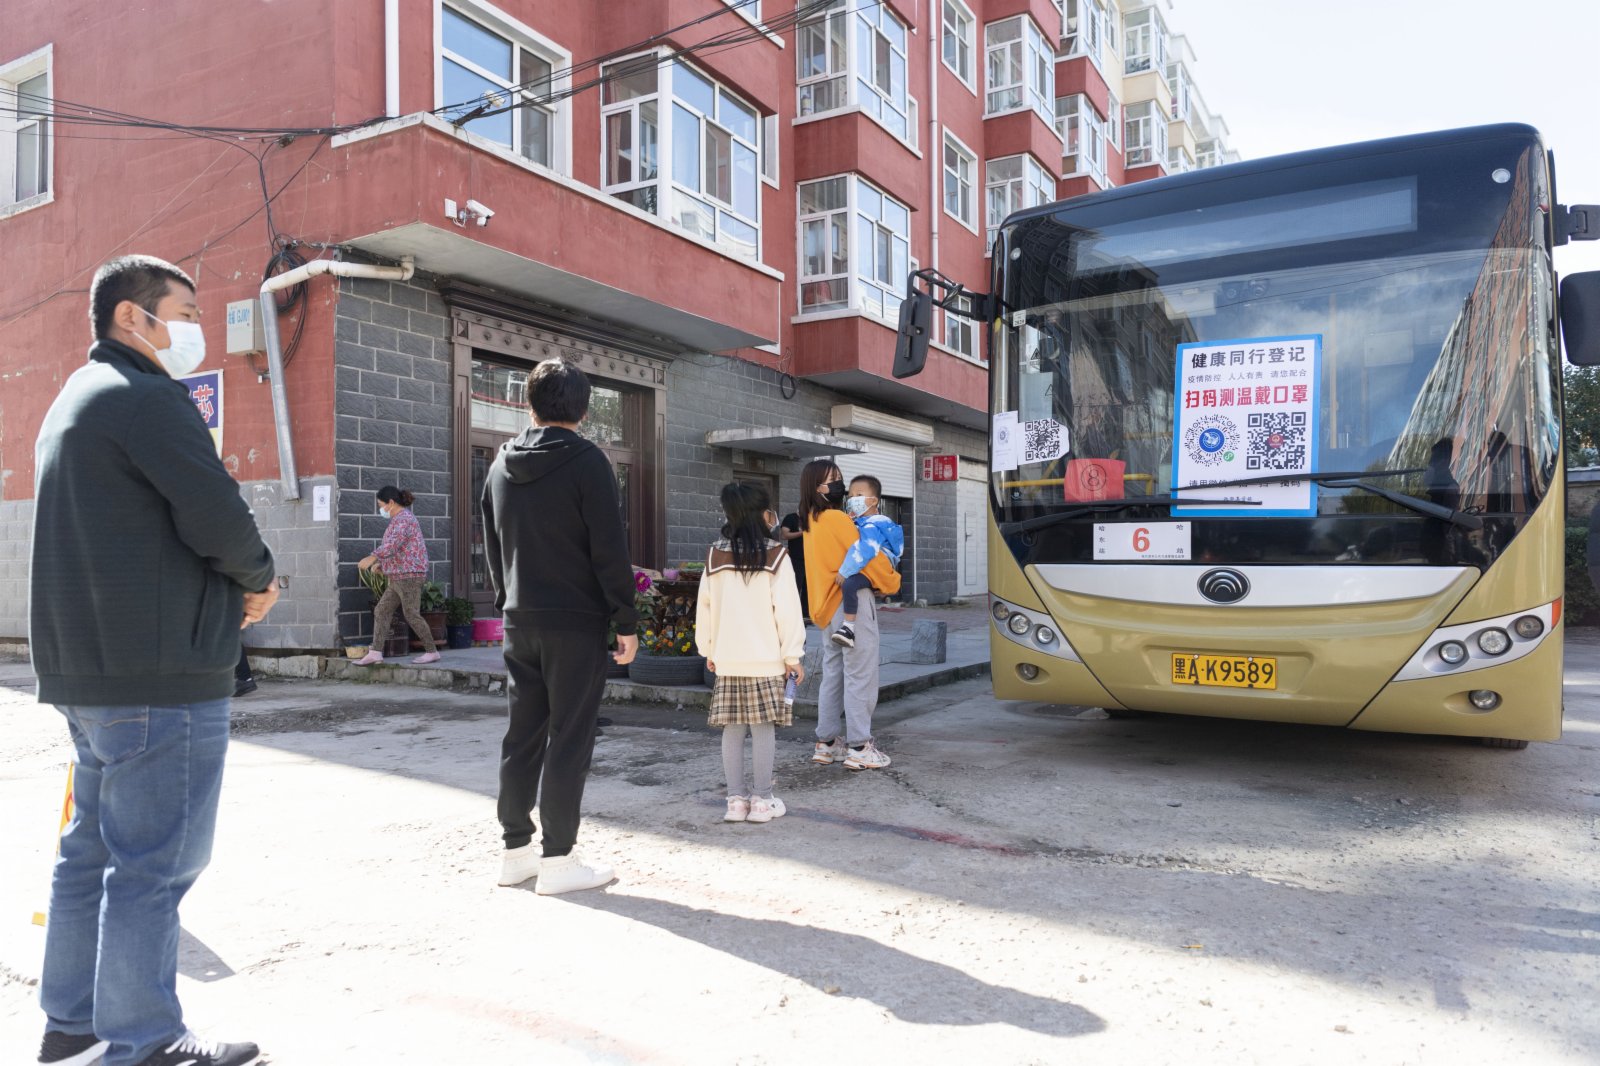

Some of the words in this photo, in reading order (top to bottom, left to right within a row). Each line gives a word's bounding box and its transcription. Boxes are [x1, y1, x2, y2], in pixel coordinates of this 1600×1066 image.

[1192, 346, 1306, 369] 健康同行登记
[1187, 373, 1222, 384] 疫情防控
[1228, 371, 1263, 381] 人人有责
[1270, 368, 1307, 378] 请您配合
[1185, 384, 1308, 409] 扫码测温戴口罩
[1132, 527, 1150, 553] 6
